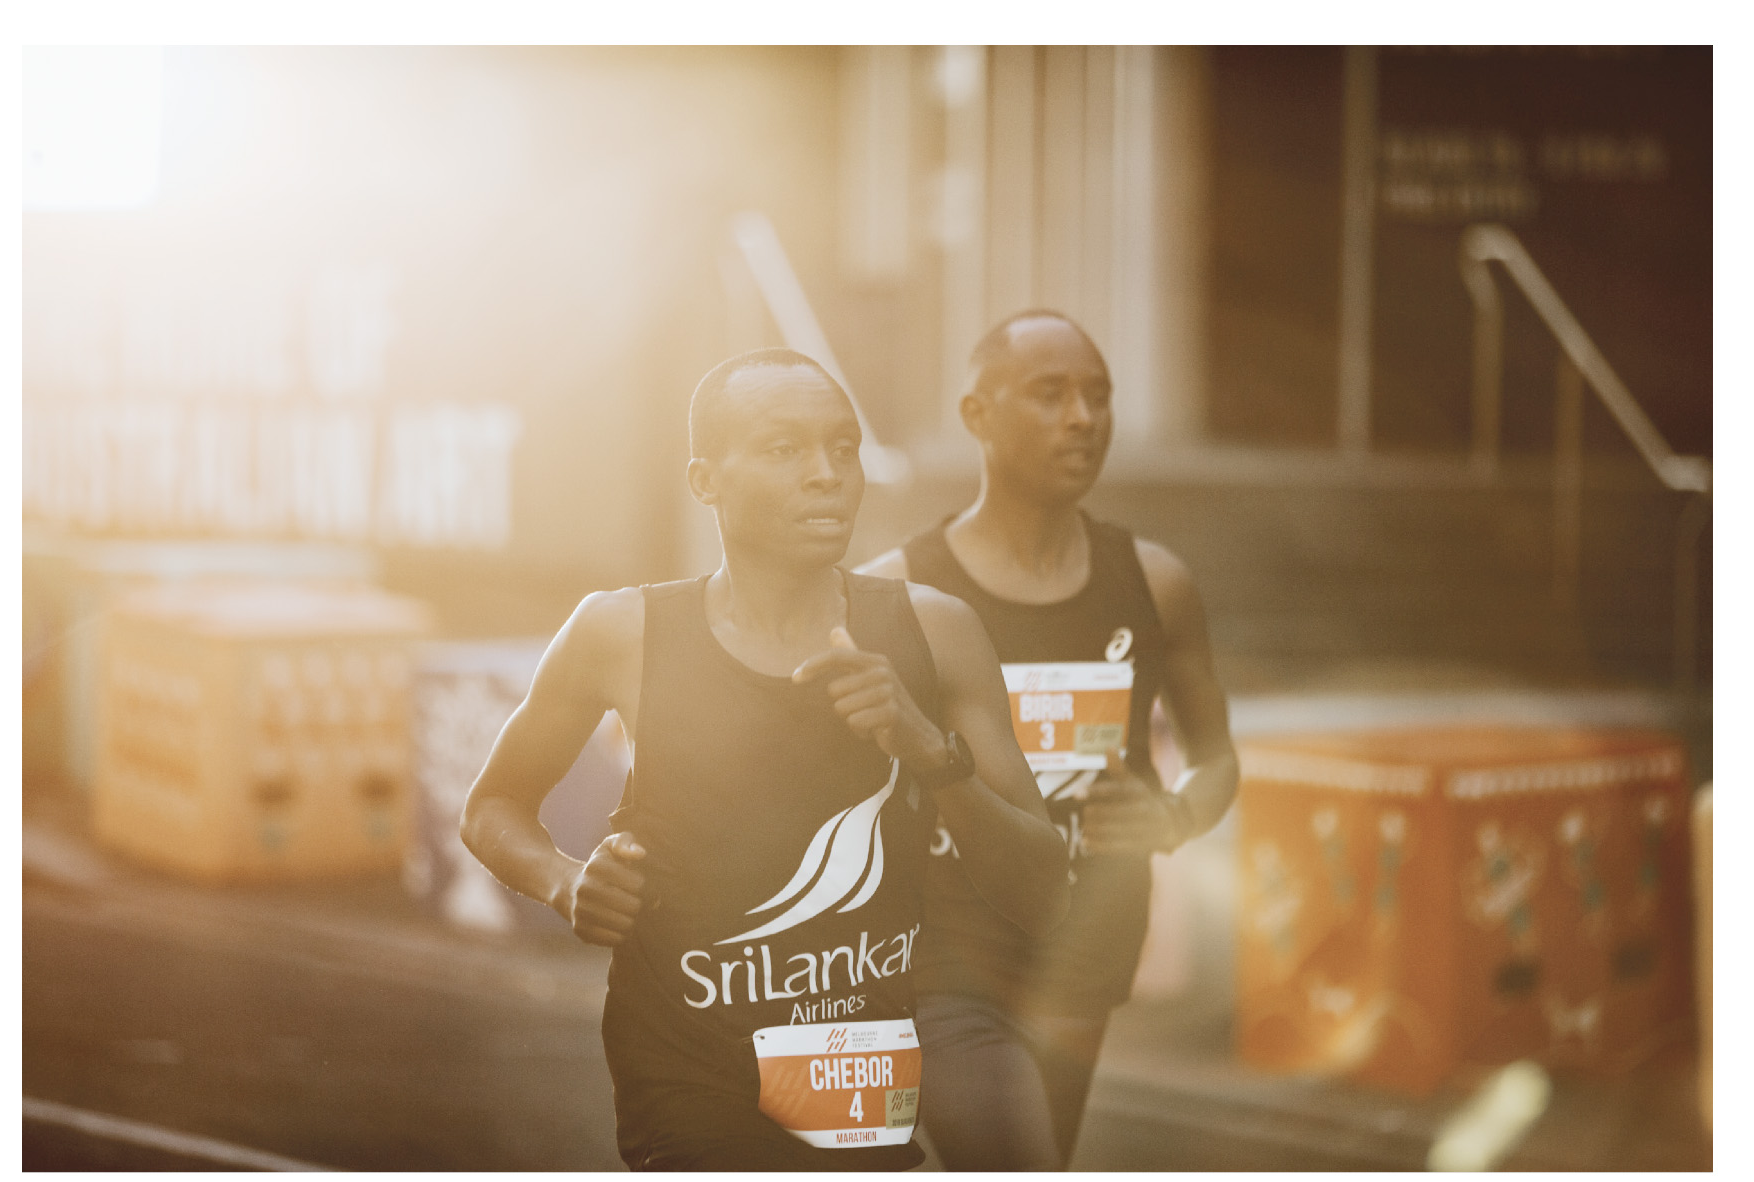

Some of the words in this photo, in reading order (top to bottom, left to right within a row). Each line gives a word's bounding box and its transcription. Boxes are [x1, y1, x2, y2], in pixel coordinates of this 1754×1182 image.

[1040, 721, 1055, 750] 3
[789, 994, 866, 1026] Airlines
[809, 1055, 893, 1091] CHEBOR
[849, 1090, 864, 1122] 4
[836, 1131, 877, 1144] MARATHON
